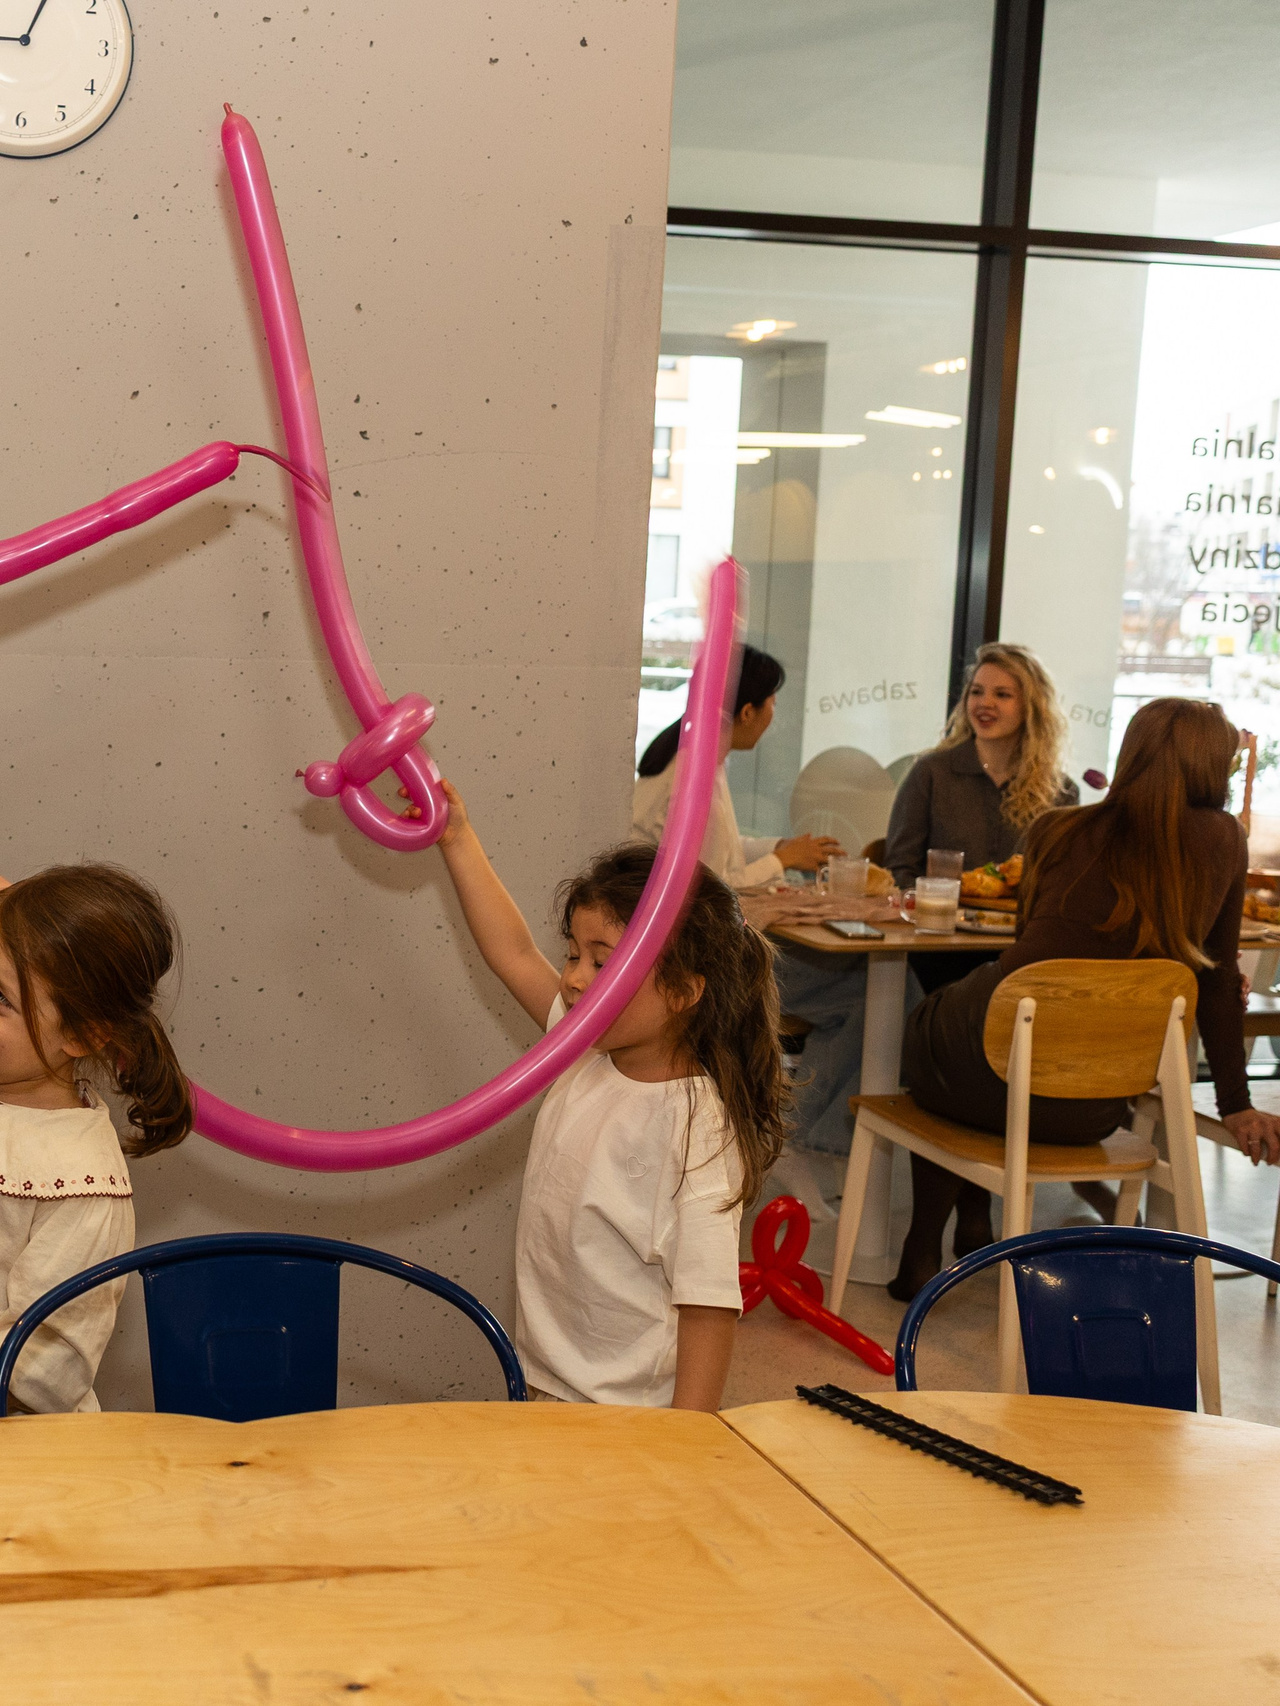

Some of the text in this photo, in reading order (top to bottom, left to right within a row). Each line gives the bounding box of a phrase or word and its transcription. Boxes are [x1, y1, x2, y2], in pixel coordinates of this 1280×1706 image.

[85, 0, 97, 14] 2
[97, 39, 109, 57] 3
[84, 79, 96, 95] 4
[15, 111, 27, 129] 6
[54, 104, 66, 122] 5
